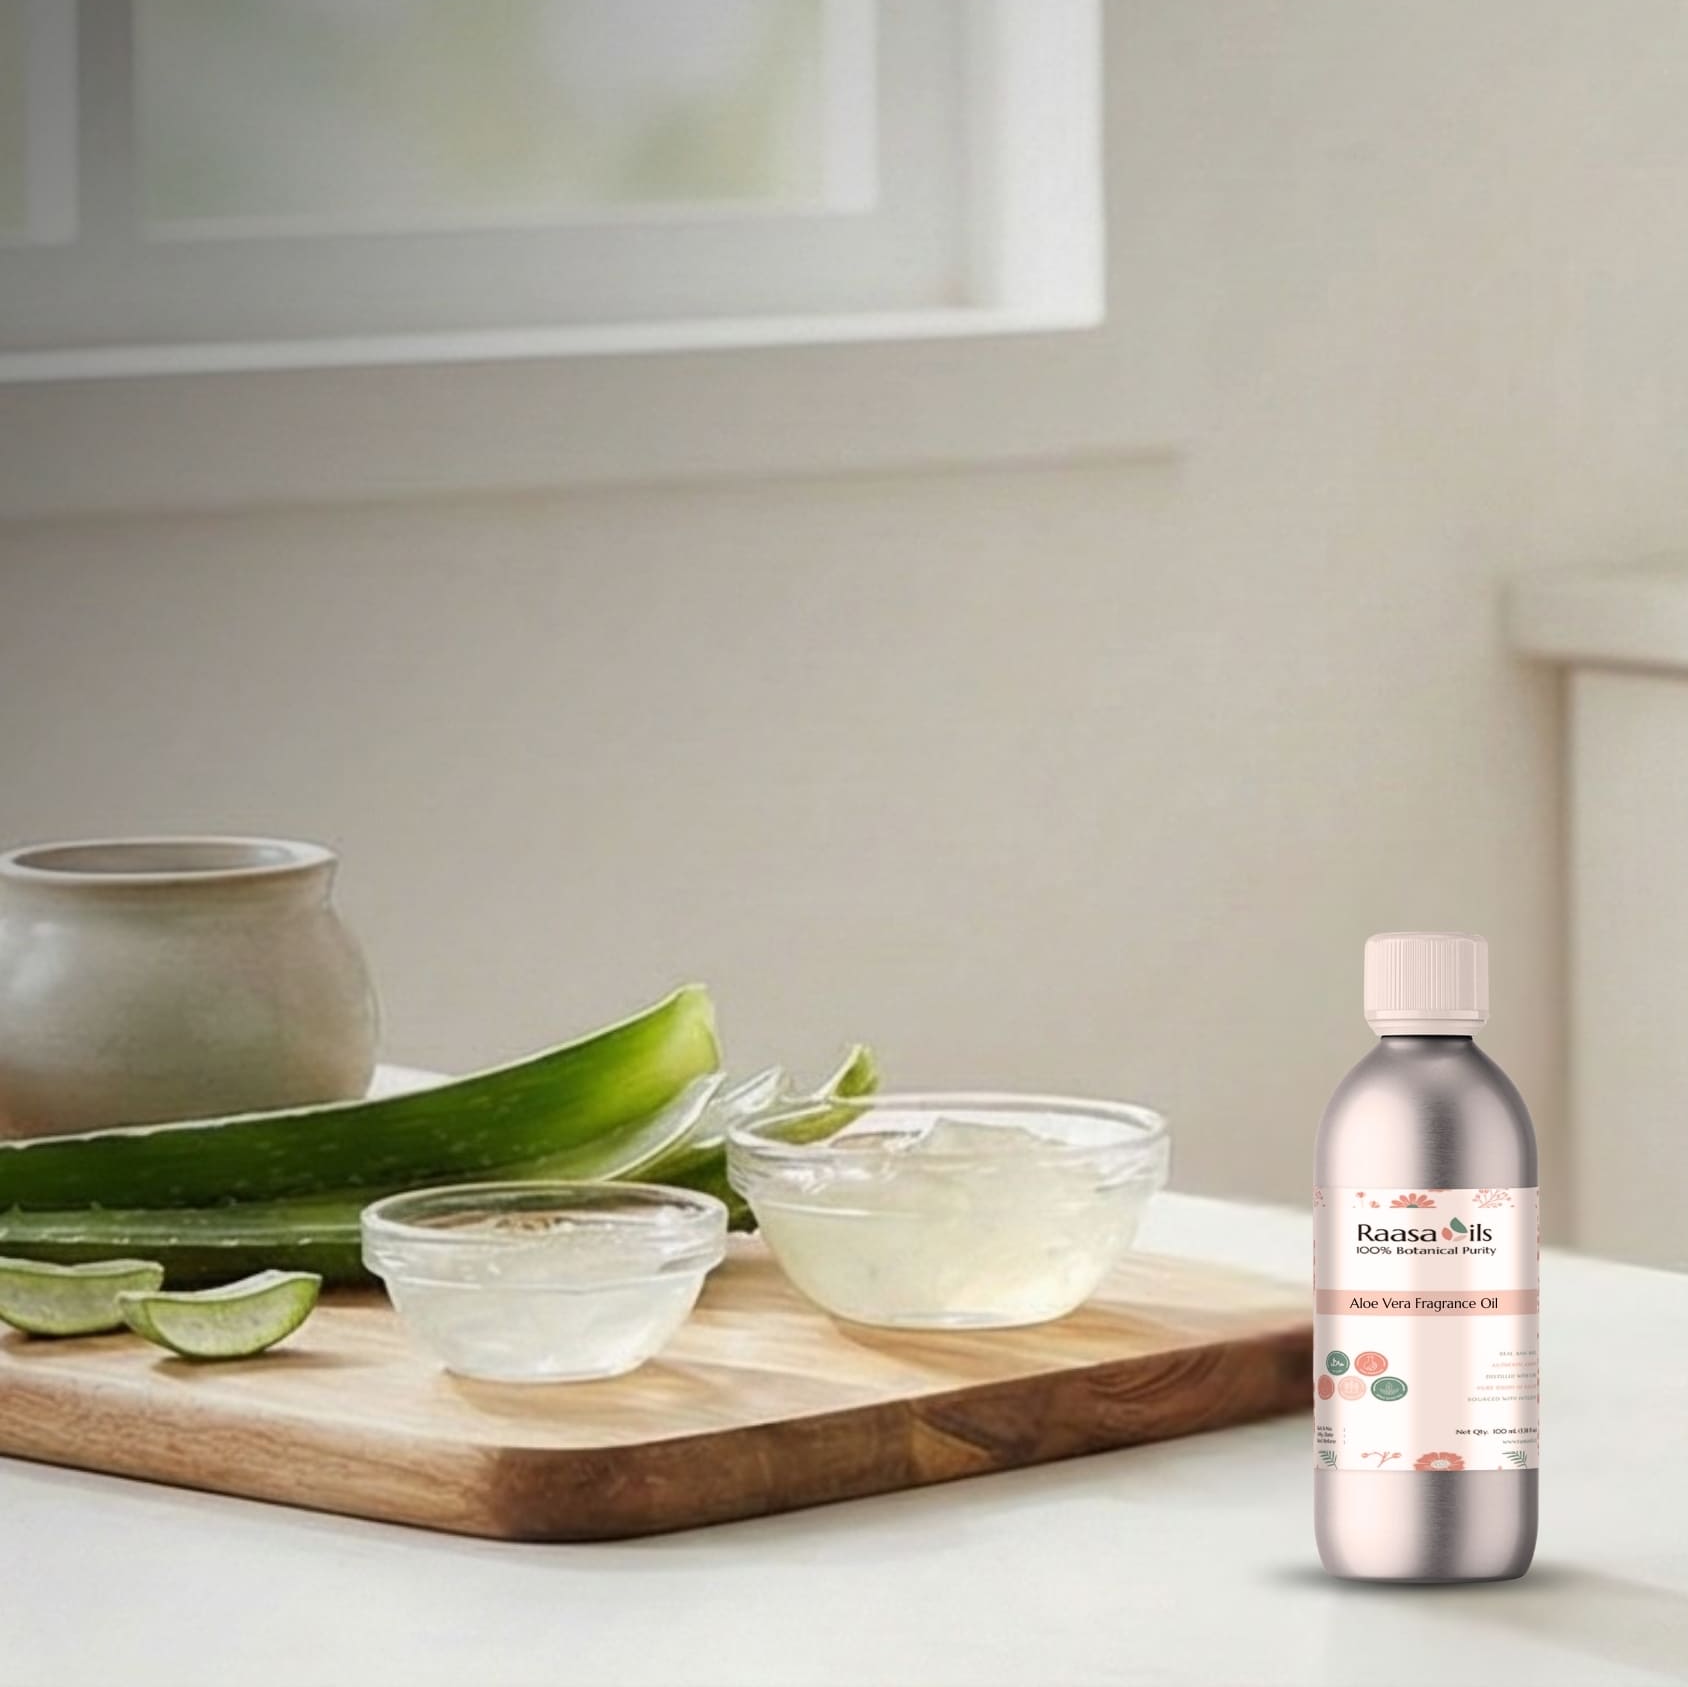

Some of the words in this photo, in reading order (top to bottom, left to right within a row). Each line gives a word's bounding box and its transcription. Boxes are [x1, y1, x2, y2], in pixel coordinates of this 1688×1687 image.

[1357, 1223, 1437, 1242] Raasa
[1356, 1246, 1392, 1255] 100%
[1396, 1246, 1458, 1255] Botanical
[1462, 1246, 1497, 1256] Purity
[1349, 1297, 1379, 1309] Aloe
[1382, 1297, 1411, 1309] Vera
[1415, 1297, 1476, 1312] Fragrance
[1480, 1297, 1498, 1309] Oil
